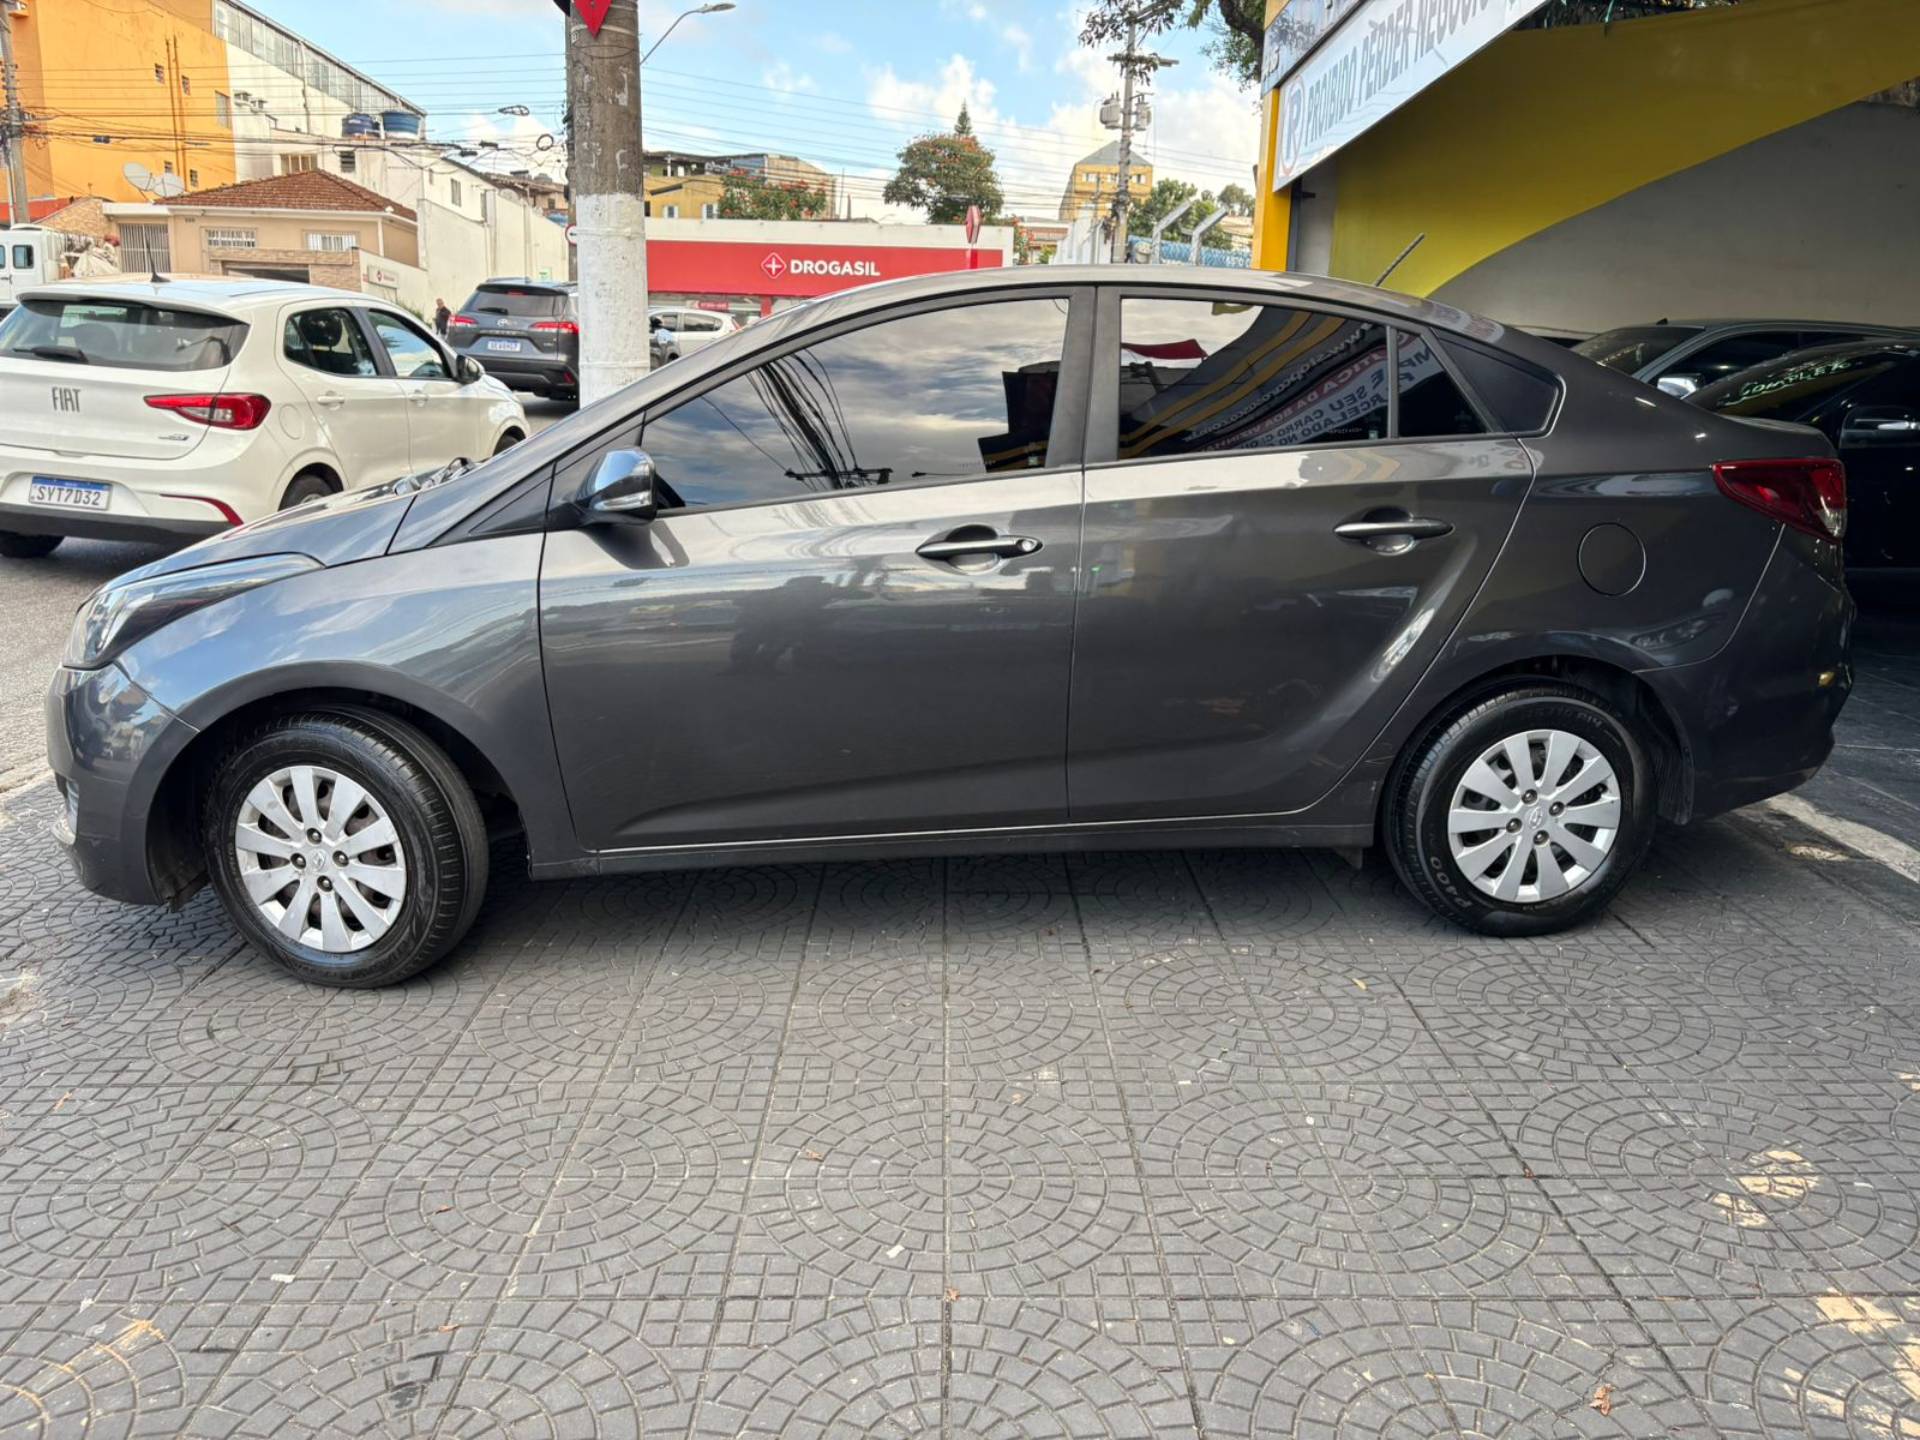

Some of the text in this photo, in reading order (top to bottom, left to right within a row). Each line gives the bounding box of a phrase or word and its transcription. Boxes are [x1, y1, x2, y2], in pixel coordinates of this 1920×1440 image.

[1305, 46, 1358, 146] PROIBIDO
[1358, 0, 1414, 107] PERDER
[789, 258, 881, 277] DROGASIL
[51, 386, 81, 413] FIAT
[37, 485, 101, 506] SYT7D32
